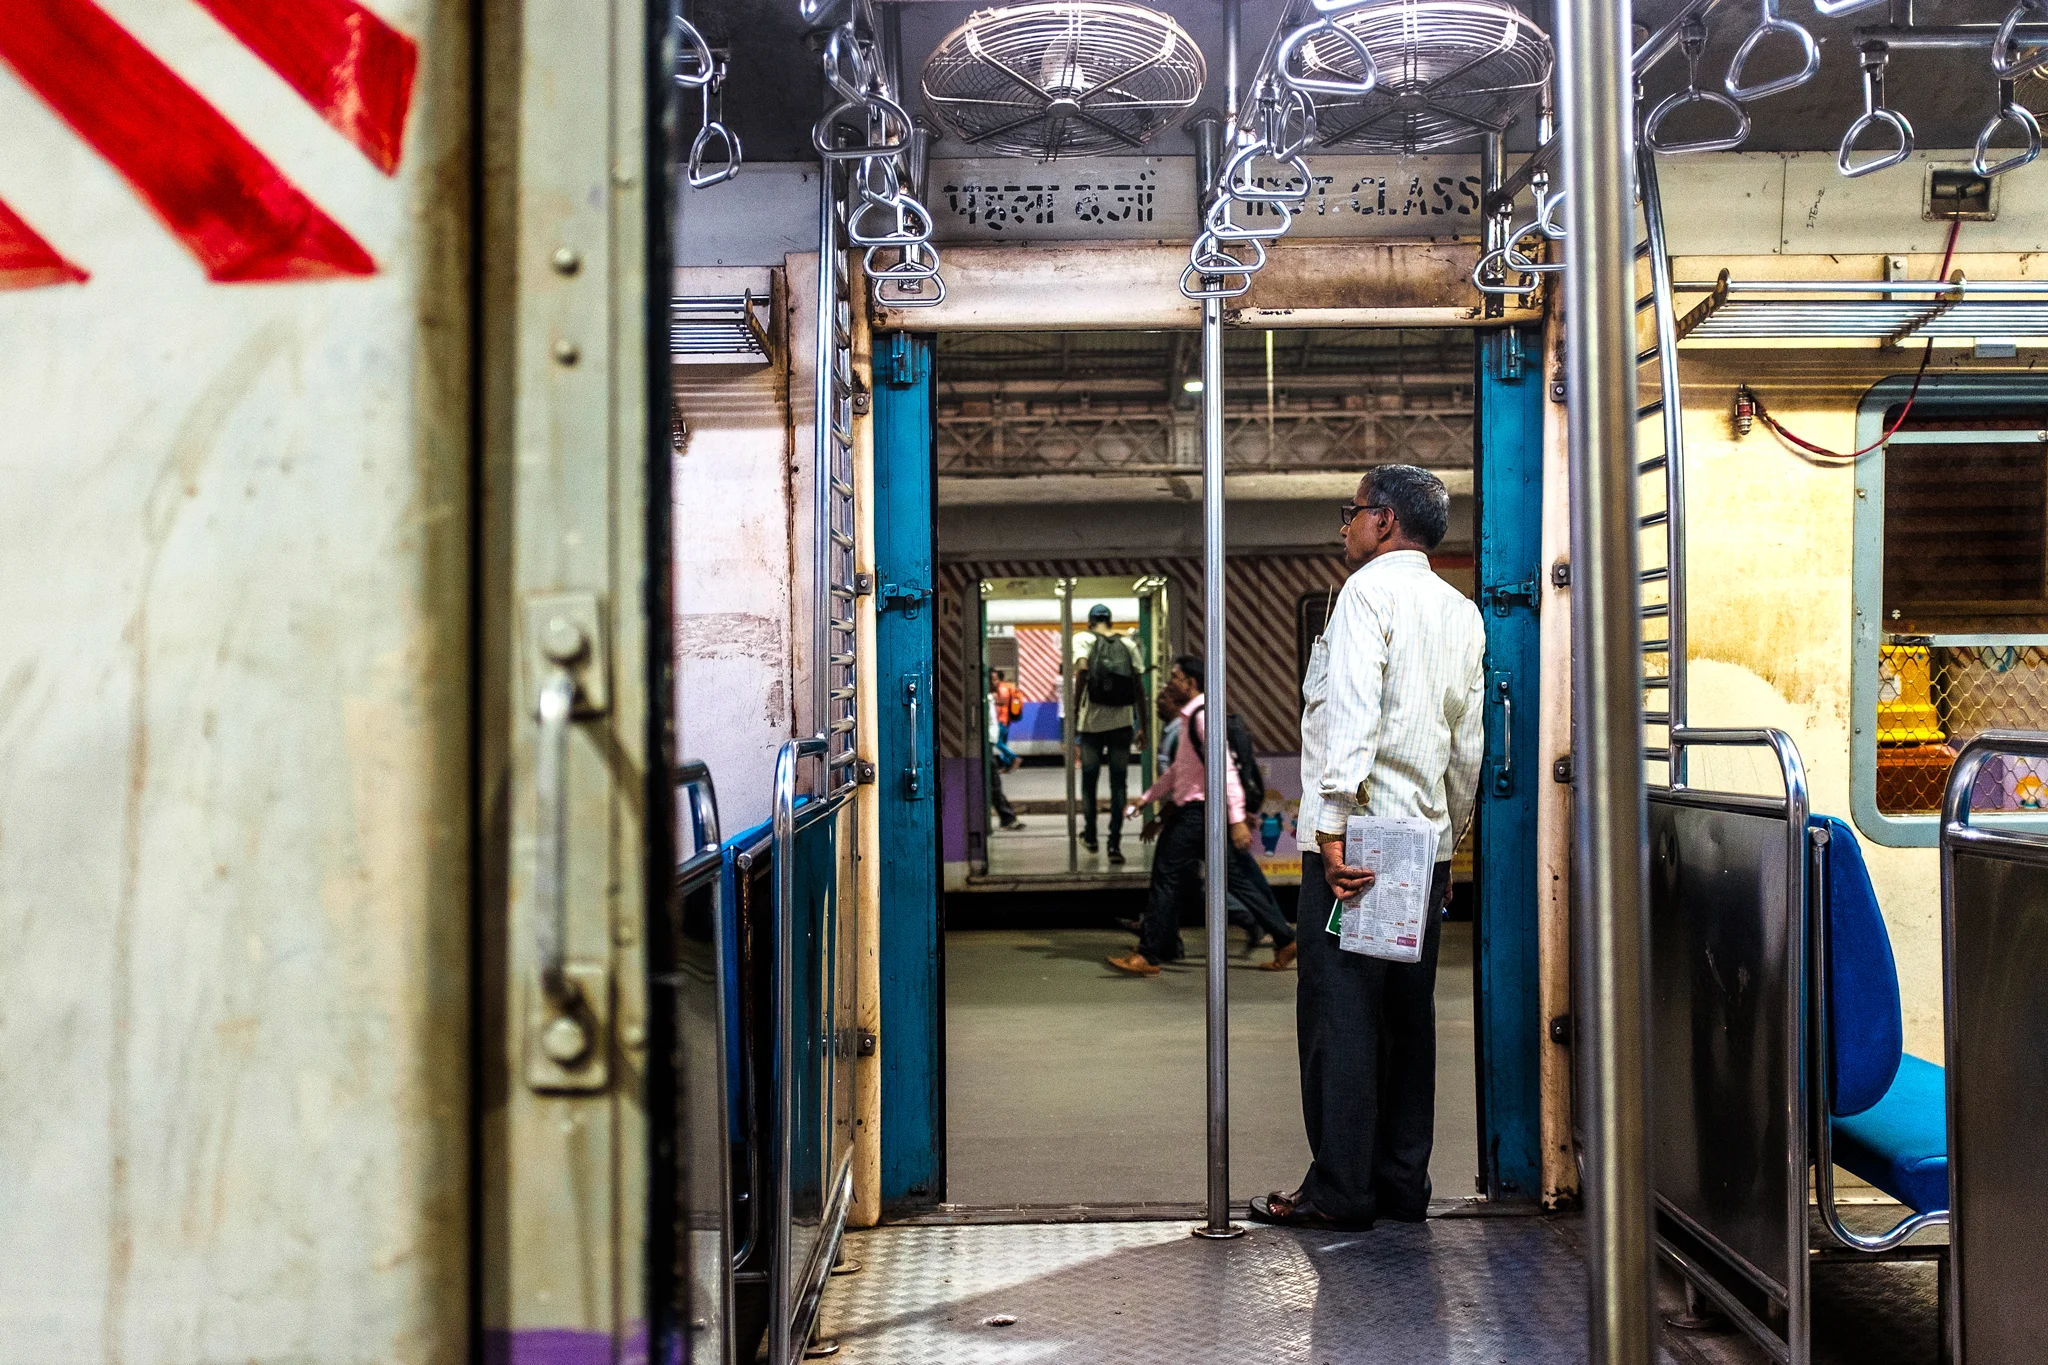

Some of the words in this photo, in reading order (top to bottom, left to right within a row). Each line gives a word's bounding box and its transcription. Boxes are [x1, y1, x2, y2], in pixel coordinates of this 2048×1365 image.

[943, 184, 1060, 231] पहला
[1074, 169, 1156, 222] दर्जा
[1231, 175, 1334, 216] RST
[1351, 175, 1482, 216] CLASS
